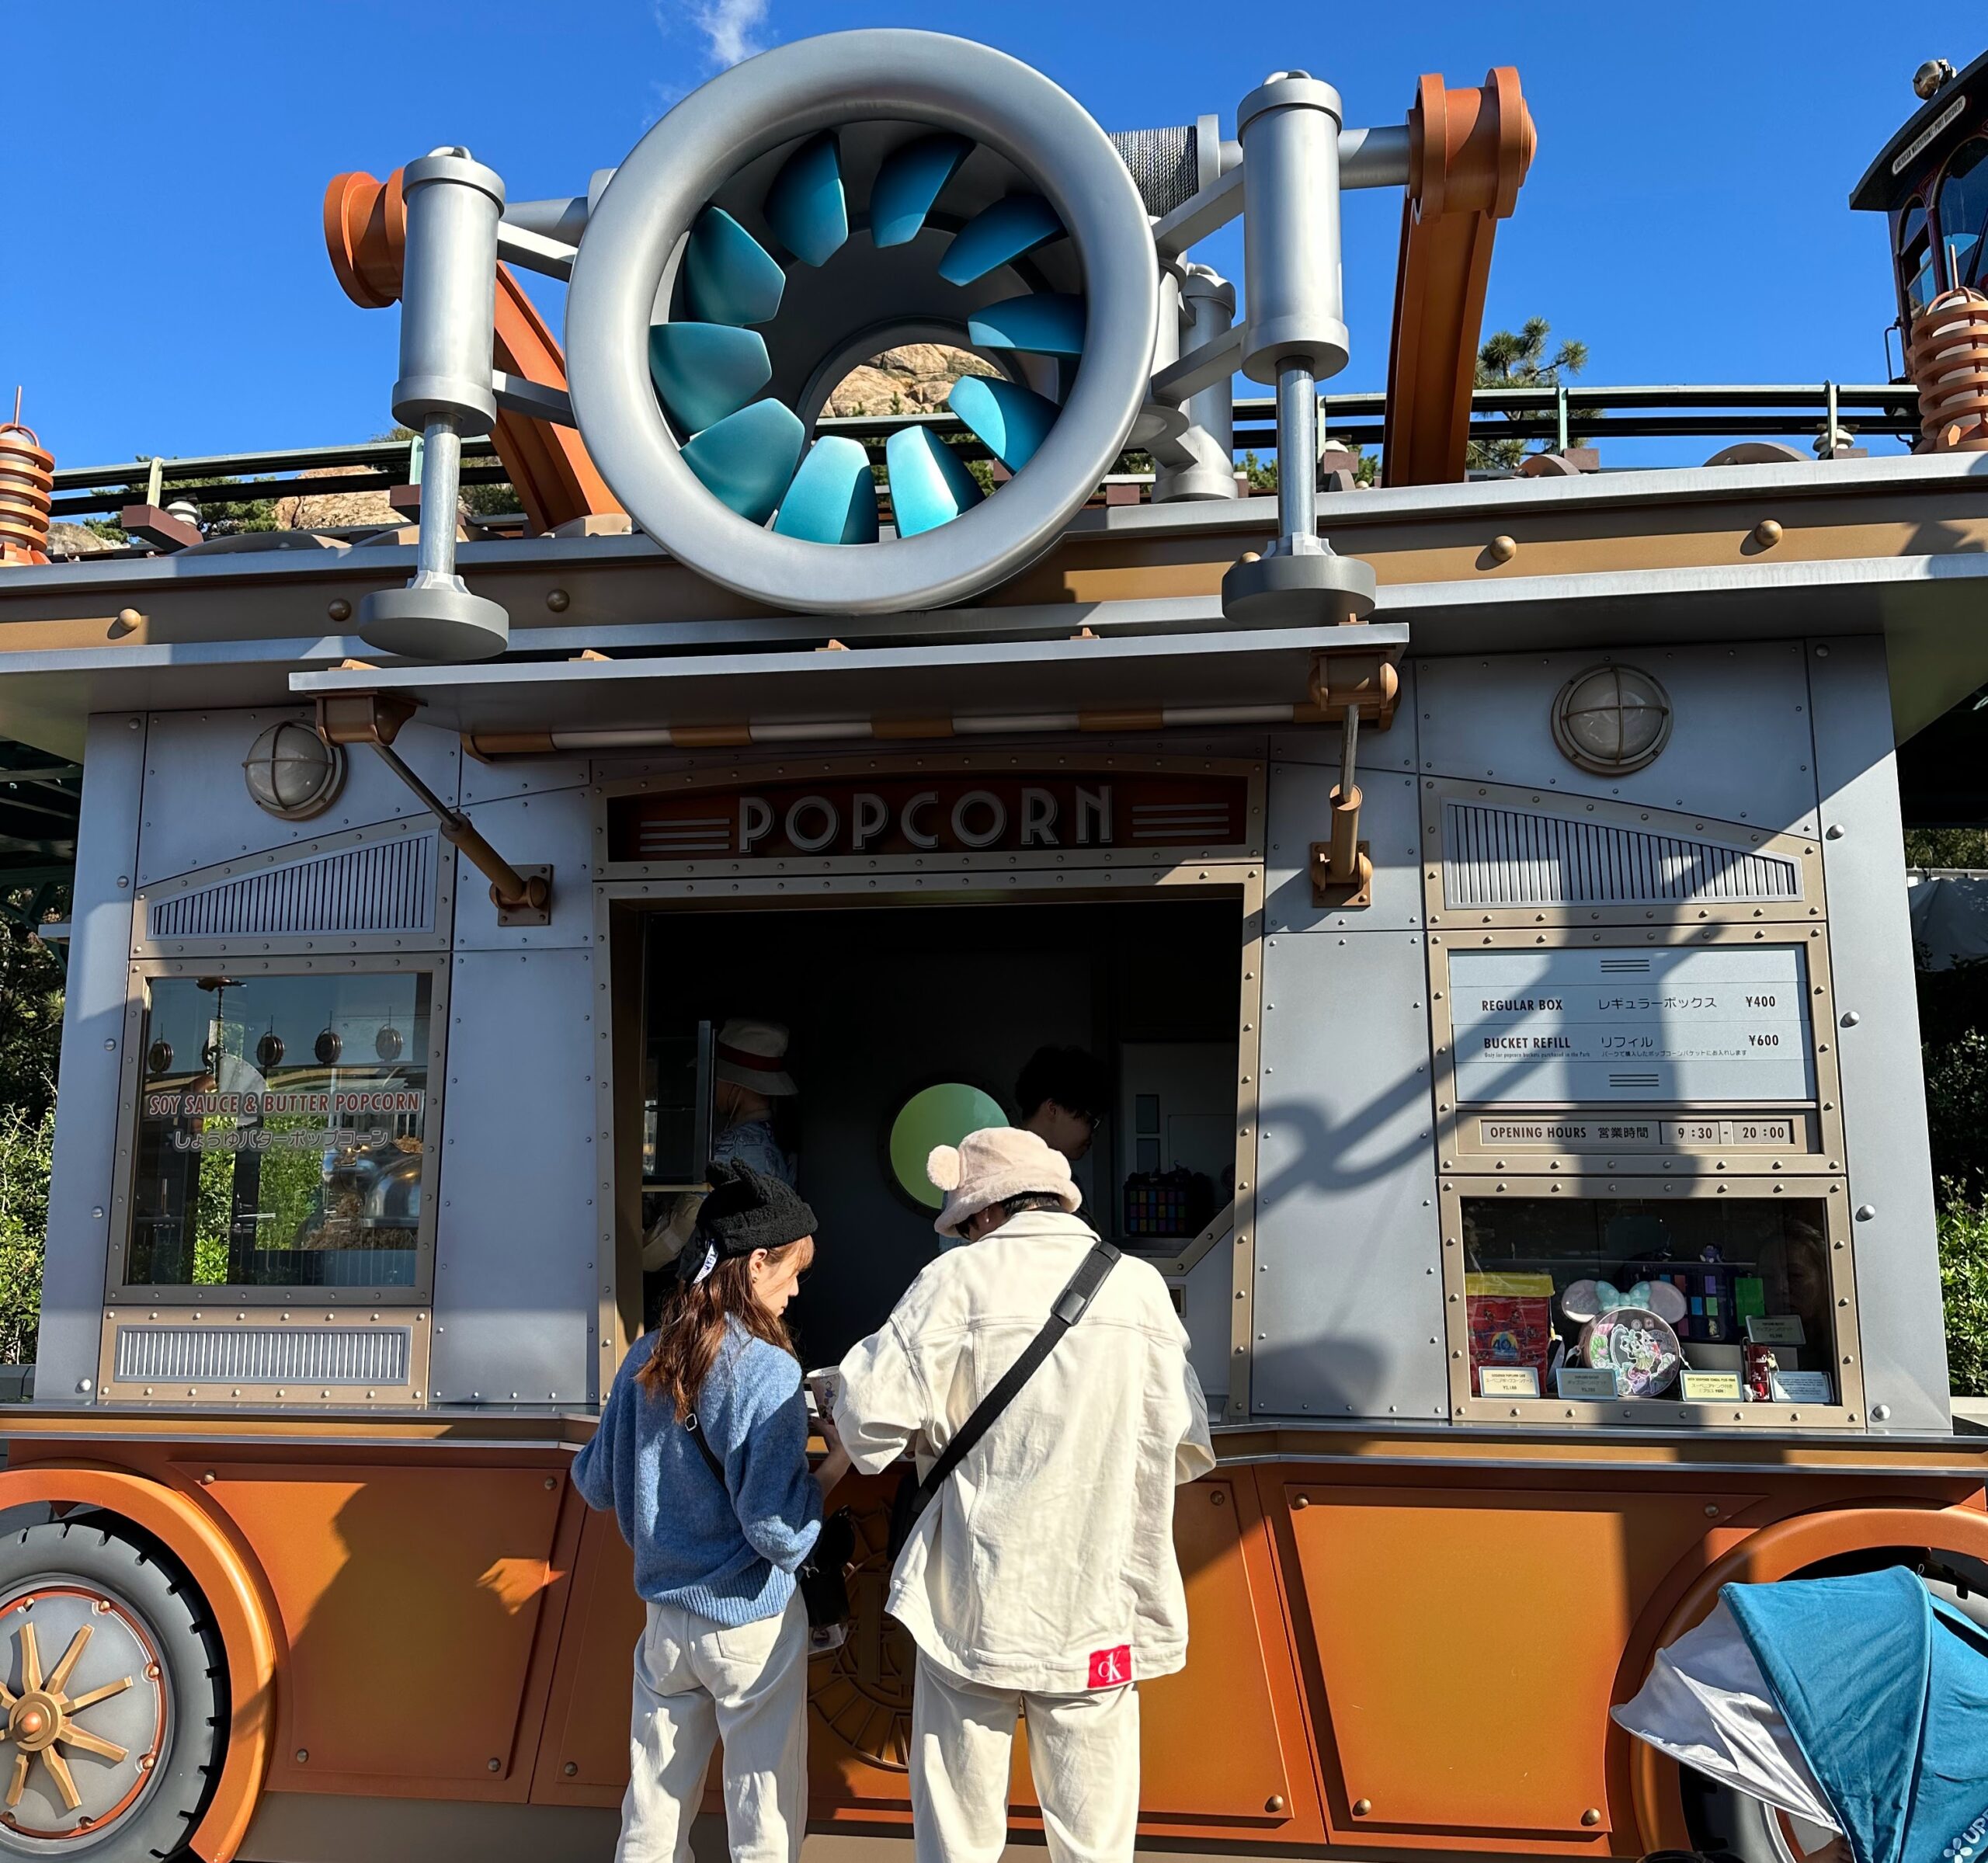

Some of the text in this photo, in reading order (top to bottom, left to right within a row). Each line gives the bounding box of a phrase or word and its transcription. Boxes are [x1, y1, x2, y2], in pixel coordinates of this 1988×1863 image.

[1895, 150, 1912, 171] AMERICAN
[1944, 101, 1963, 123] DISCOVERY
[739, 785, 1113, 853] POPCORN
[1482, 999, 1563, 1011] REGULAR BOX
[1598, 997, 1718, 1010] レギュラーボックス
[1745, 996, 1776, 1007] ¥400
[1484, 1037, 1571, 1048] BUCKET REFILL
[1601, 1037, 1653, 1048] リフィル
[1748, 1034, 1779, 1046] ¥600
[149, 1092, 420, 1115] SOY SAUCE & BUTTER POPCORN
[175, 1128, 388, 1149] しょうゆバターポップコーン
[1490, 1127, 1587, 1138] OPENING HOURS
[1597, 1127, 1649, 1138] 営業時間
